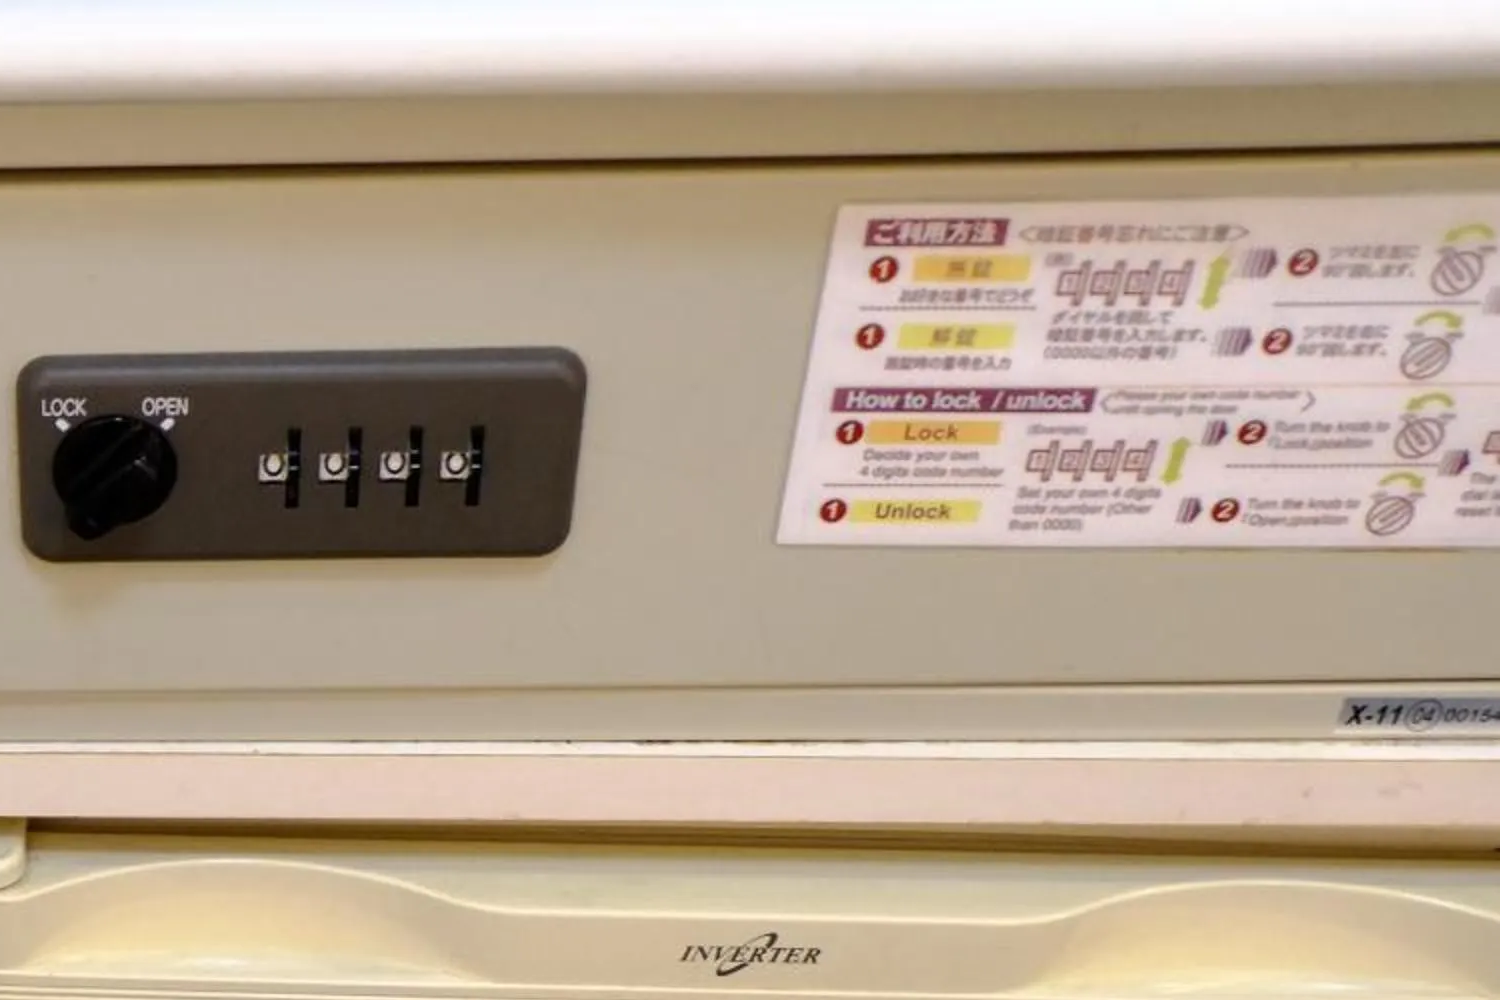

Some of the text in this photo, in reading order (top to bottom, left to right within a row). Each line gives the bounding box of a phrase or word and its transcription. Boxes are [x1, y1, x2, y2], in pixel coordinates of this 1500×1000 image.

[872, 219, 999, 244] ご利用方法
[41, 397, 87, 418] LOCK
[141, 396, 189, 417] OPEN
[846, 390, 898, 409] How
[903, 391, 926, 409] to
[932, 390, 982, 410] lock
[1005, 390, 1086, 410] unlock
[904, 423, 959, 441] Lock
[876, 502, 952, 520] Unlock
[1344, 703, 1404, 727] X-11
[680, 944, 822, 965] INVERTER
